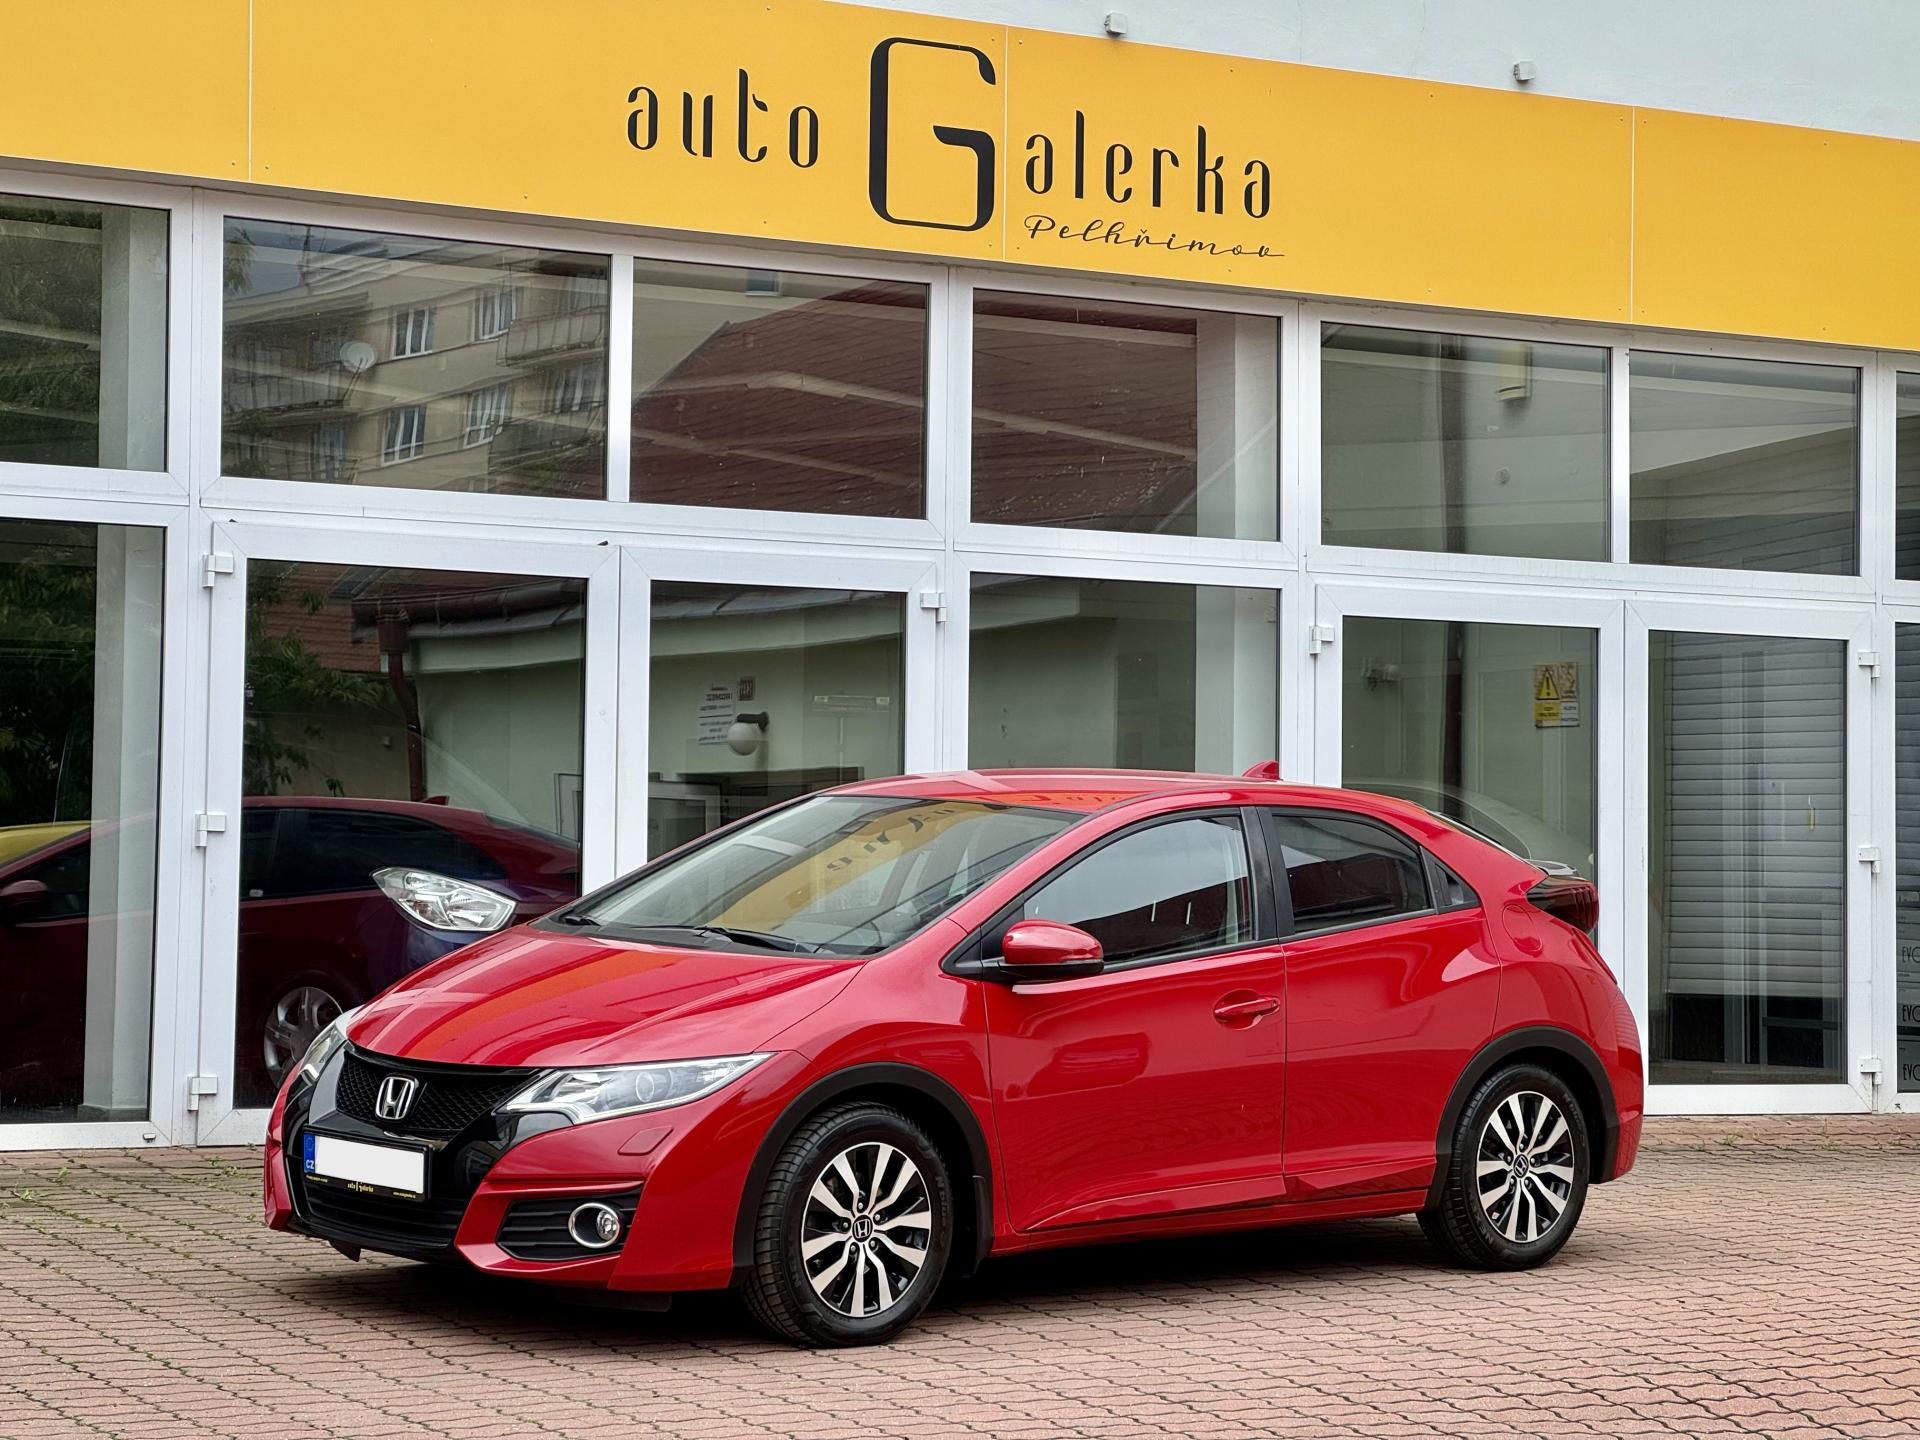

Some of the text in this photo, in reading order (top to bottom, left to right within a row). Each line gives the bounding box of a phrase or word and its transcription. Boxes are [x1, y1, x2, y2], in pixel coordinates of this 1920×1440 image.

[628, 68, 819, 169] auto
[1023, 214, 1285, 257] Pelhřimov
[305, 1159, 315, 1170] CZ
